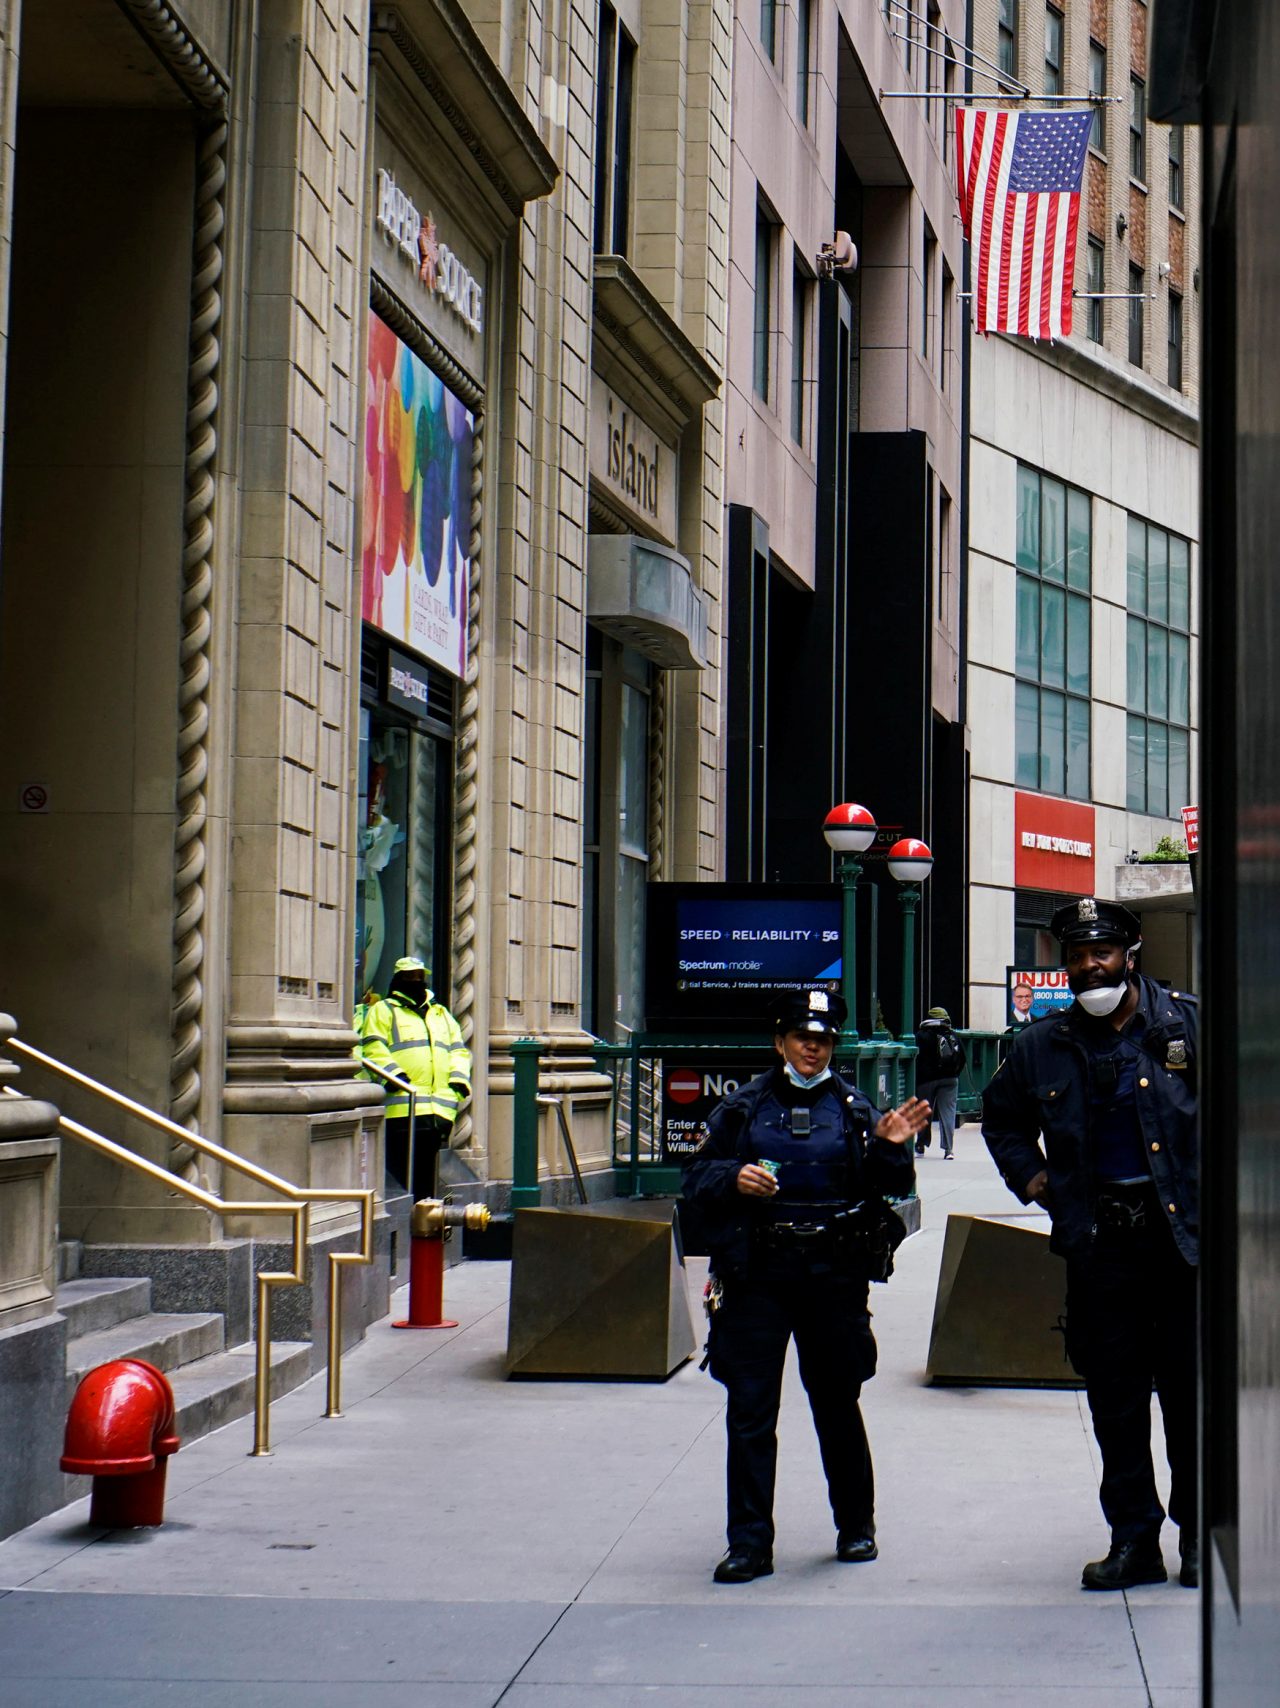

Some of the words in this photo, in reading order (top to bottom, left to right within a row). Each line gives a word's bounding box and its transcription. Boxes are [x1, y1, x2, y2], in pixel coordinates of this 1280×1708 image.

[377, 167, 421, 267] PAPER
[436, 242, 482, 334] SOURCE
[607, 396, 659, 519] island
[680, 929, 722, 940] SPEED
[732, 930, 811, 941] RELIABILITY
[822, 930, 839, 942] 5G
[679, 959, 725, 972] Spectrum
[728, 960, 760, 970] mobile
[702, 981, 731, 990] Service,
[732, 981, 737, 989] J
[738, 981, 760, 989] trains
[773, 981, 801, 991] running
[802, 982, 828, 991] approx
[1033, 991, 1053, 1000] (800)
[703, 1074, 739, 1096] No
[666, 1119, 696, 1130] Enter
[666, 1130, 683, 1141] for
[666, 1142, 695, 1153] Willia
